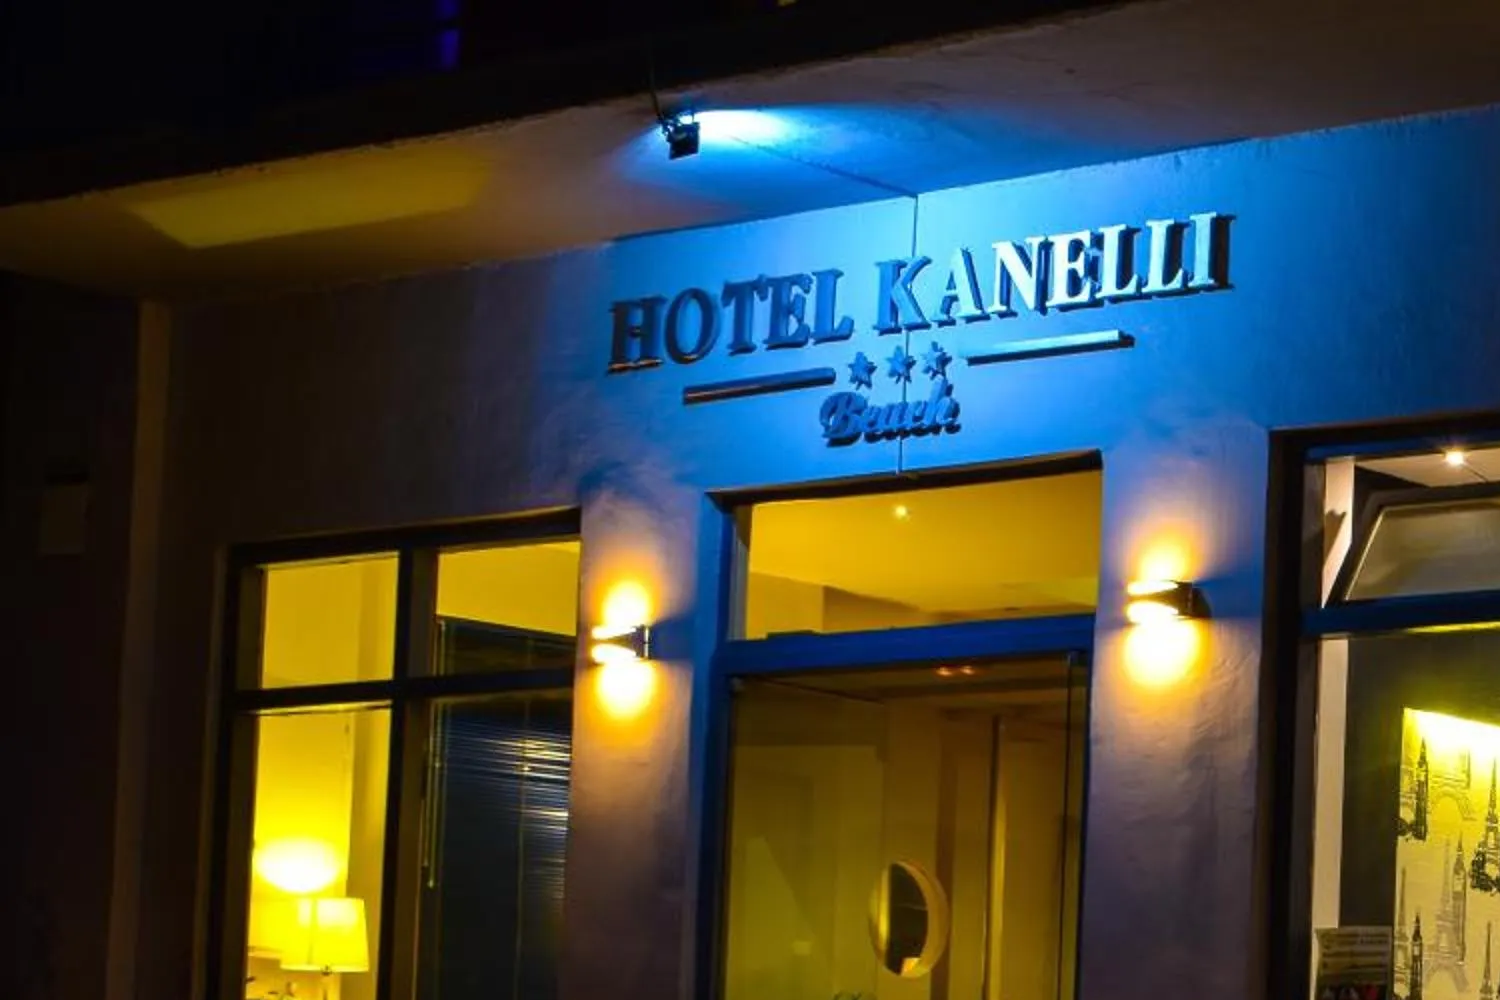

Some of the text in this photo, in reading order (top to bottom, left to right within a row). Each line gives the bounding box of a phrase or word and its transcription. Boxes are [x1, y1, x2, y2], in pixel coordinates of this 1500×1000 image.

[607, 211, 1226, 373] HOTEL KANELLI
[819, 376, 961, 447] Beach
